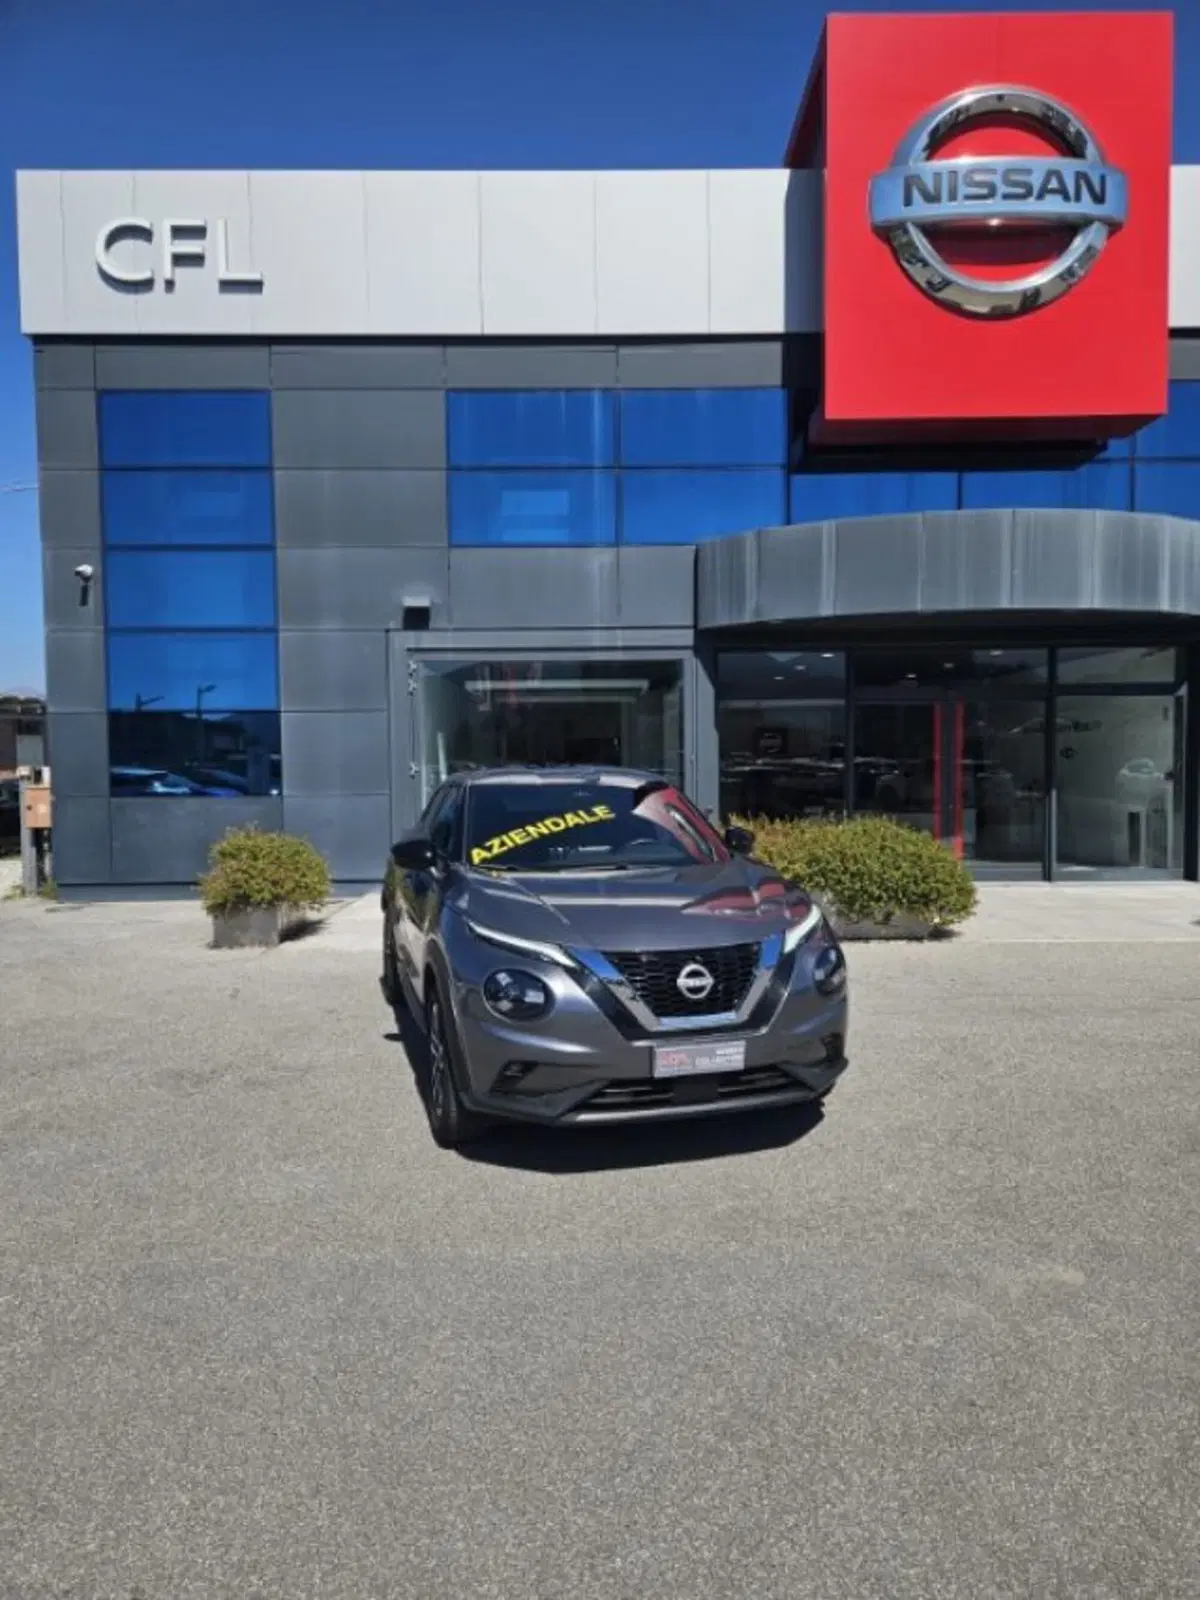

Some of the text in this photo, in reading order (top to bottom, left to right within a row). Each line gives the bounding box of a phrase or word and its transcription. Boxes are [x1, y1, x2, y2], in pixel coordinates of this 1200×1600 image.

[903, 168, 1107, 207] NISSAN
[95, 218, 263, 293] CFL
[471, 805, 616, 865] AZIENDALE
